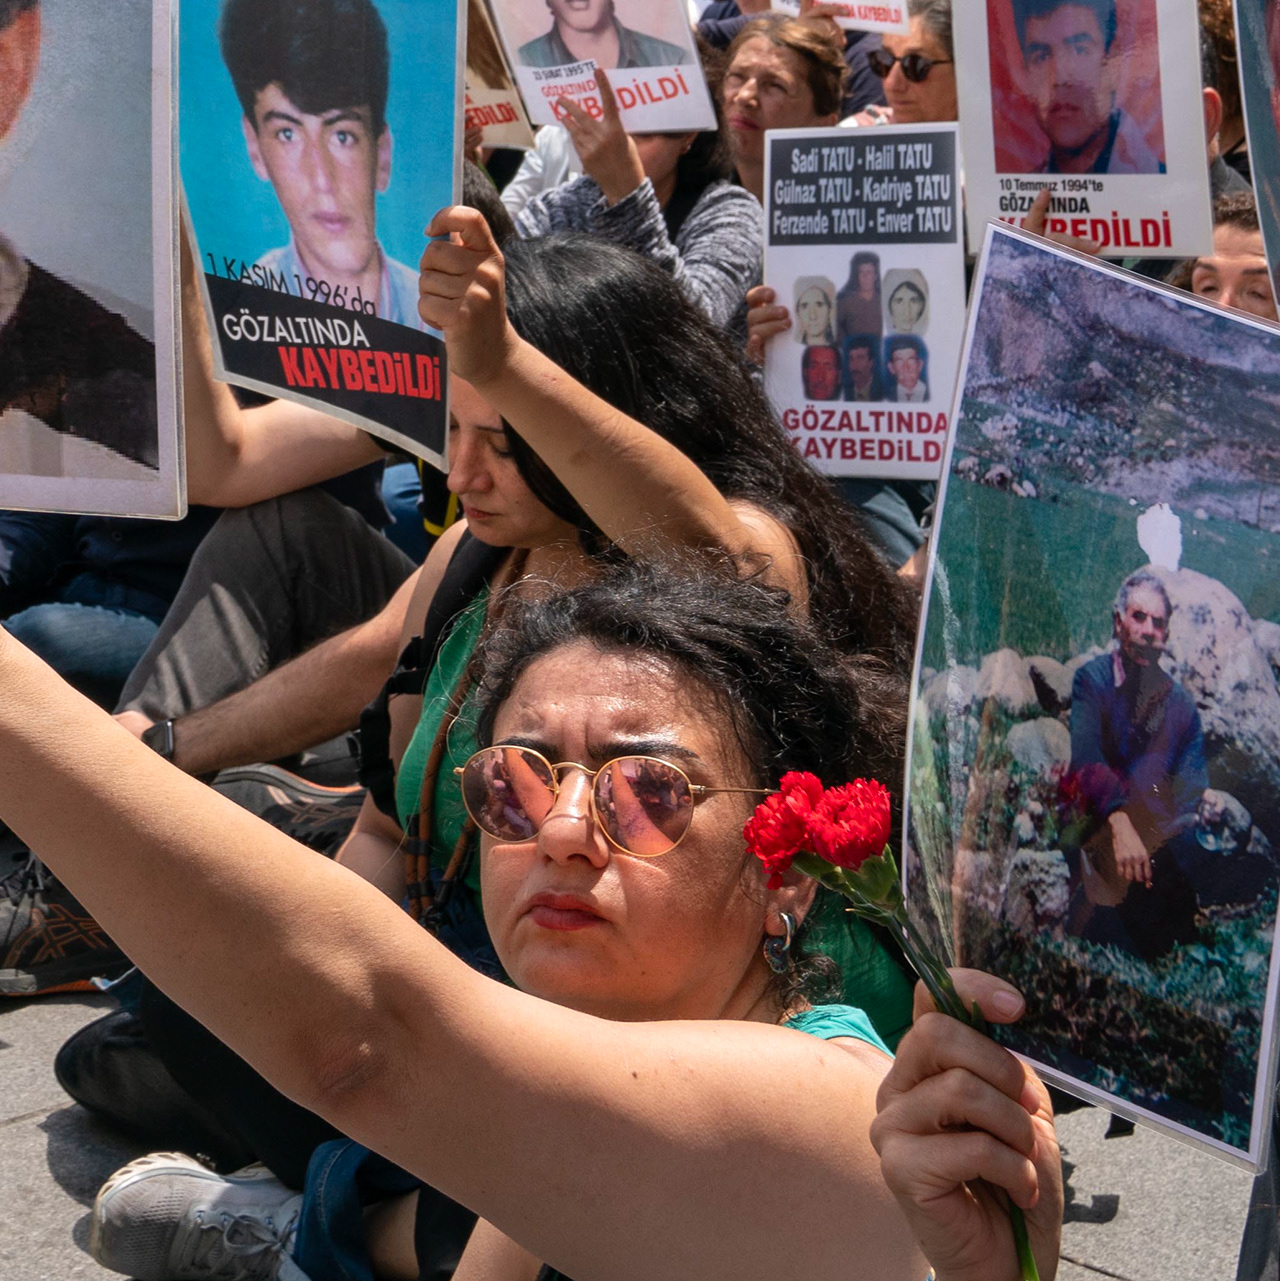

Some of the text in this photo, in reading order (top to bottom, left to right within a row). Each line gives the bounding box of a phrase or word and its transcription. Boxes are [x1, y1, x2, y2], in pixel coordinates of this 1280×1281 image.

[540, 79, 597, 98] GÖZALTIND
[548, 68, 690, 121] KYBDİLDİ
[790, 146, 819, 173] Sadi
[821, 146, 855, 172] TATU
[865, 144, 895, 170] Halil
[897, 144, 933, 169] TATU
[774, 178, 816, 206] Gülnaz
[818, 177, 852, 203] TATU
[863, 177, 913, 207] Kadriye
[915, 176, 951, 202] TATU
[1000, 179, 1104, 193] 10 Temmuz 1994'te
[999, 192, 1091, 214] GÖZAINDA
[773, 209, 829, 236] Ferzende
[831, 209, 865, 235] TATU
[877, 208, 913, 234] Enver
[915, 207, 952, 233] TATU
[223, 256, 288, 297] KASIM
[293, 271, 377, 317] 1996'da
[222, 308, 370, 350] GÖZALTINDA
[279, 346, 442, 402] KAYBEDİLDİ
[783, 405, 949, 435] GÖZALTINDA
